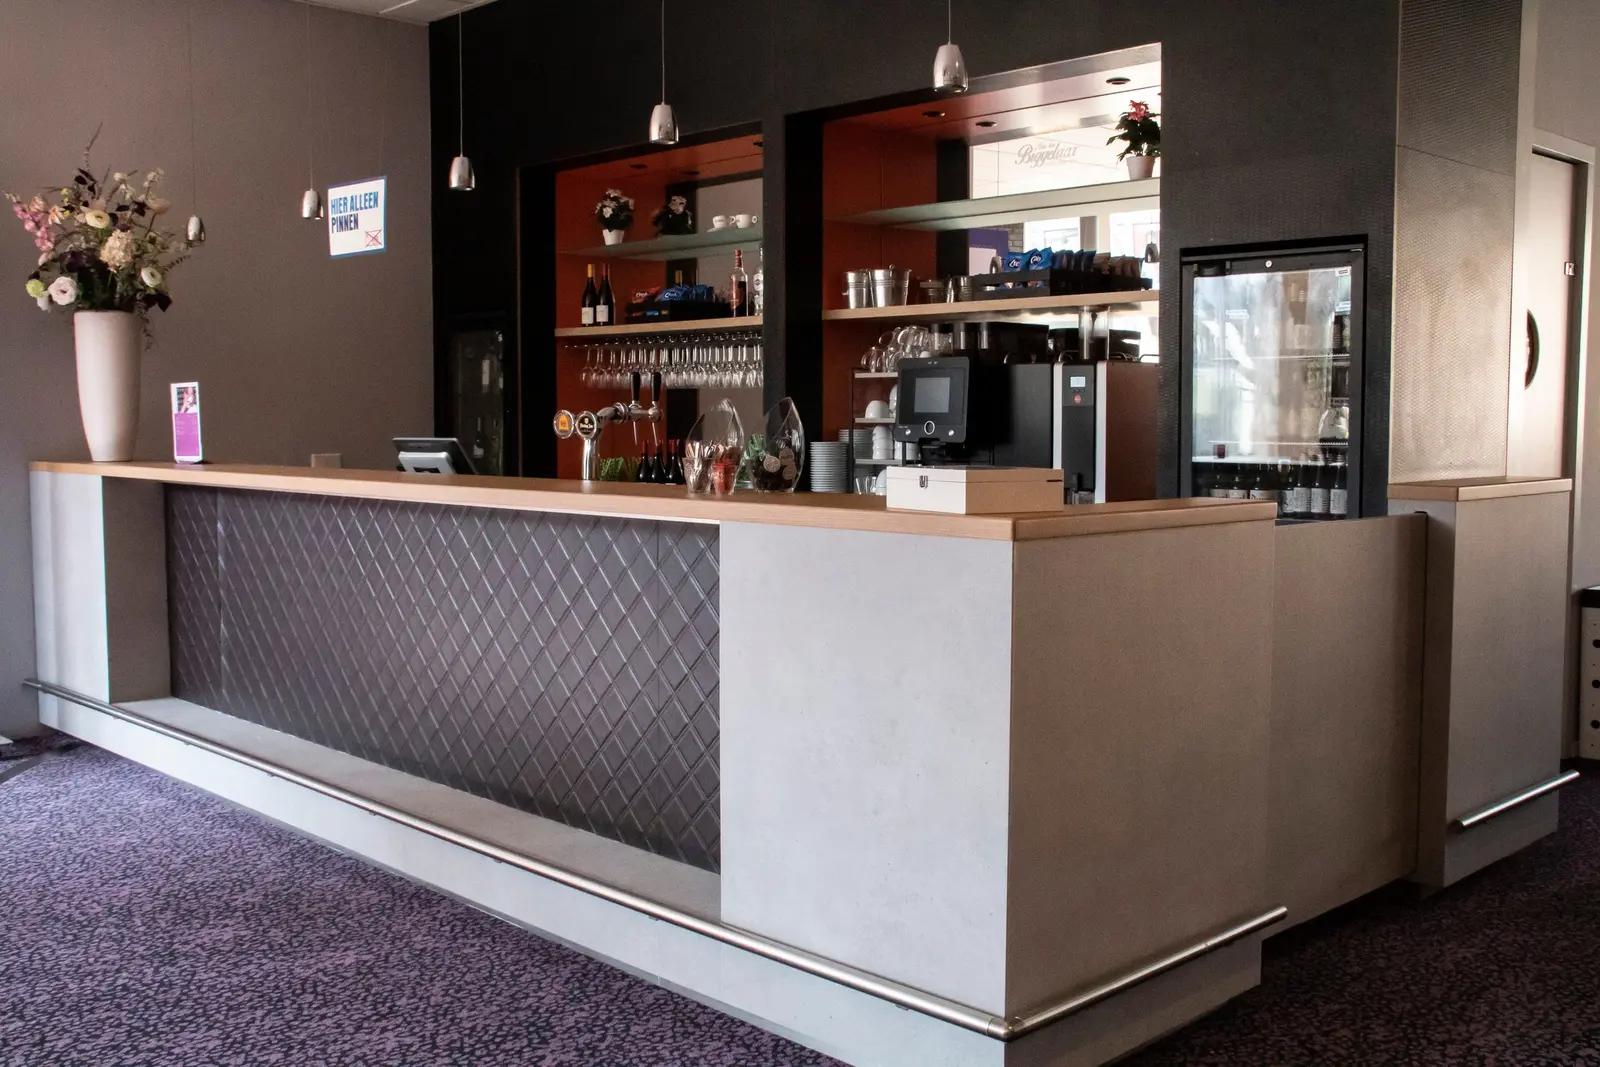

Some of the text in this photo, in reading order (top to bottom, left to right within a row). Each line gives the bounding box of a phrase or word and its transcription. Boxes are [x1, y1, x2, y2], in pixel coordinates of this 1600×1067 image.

[331, 191, 379, 214] HIER ALLEEN
[331, 213, 359, 233] PINNEN
